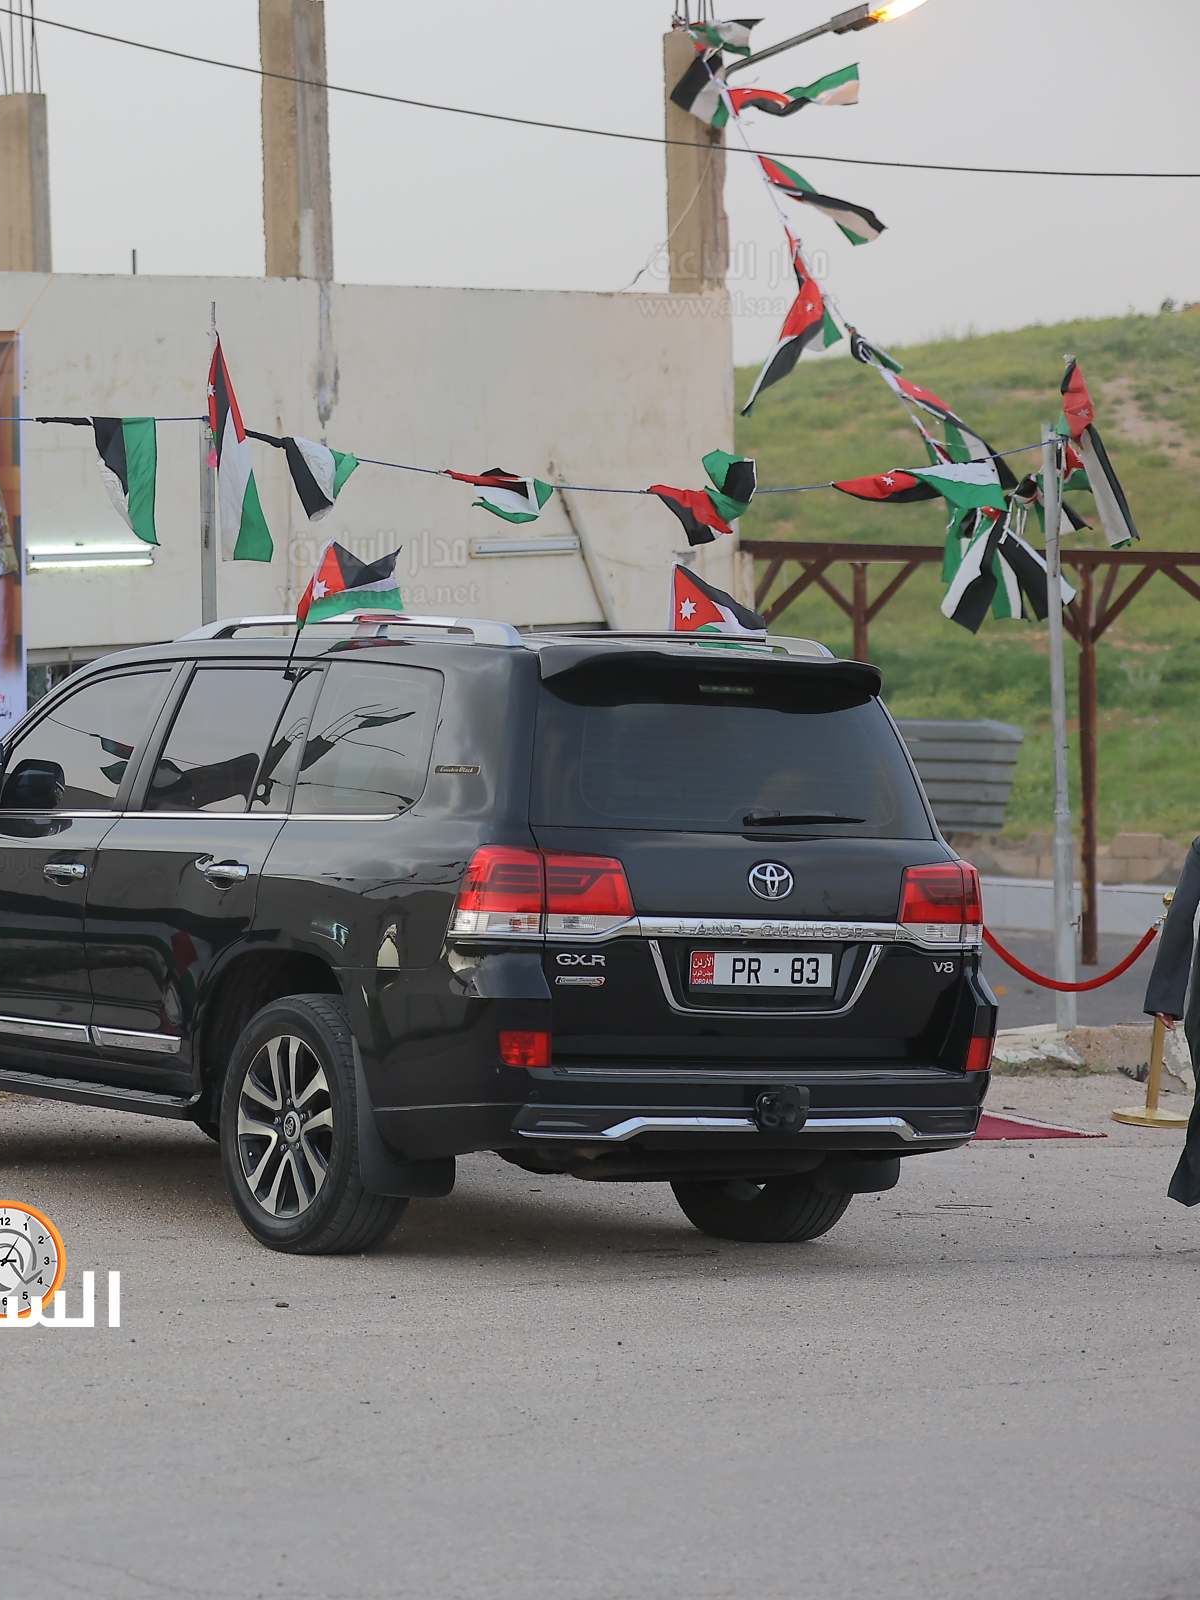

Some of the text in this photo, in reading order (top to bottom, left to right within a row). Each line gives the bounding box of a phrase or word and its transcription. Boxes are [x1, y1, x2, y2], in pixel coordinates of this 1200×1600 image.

[678, 921, 866, 938] LAND CRUISER
[556, 954, 606, 966] GXR
[692, 956, 714, 968] الأردن
[732, 958, 820, 984] PR 83
[933, 962, 954, 973] V8
